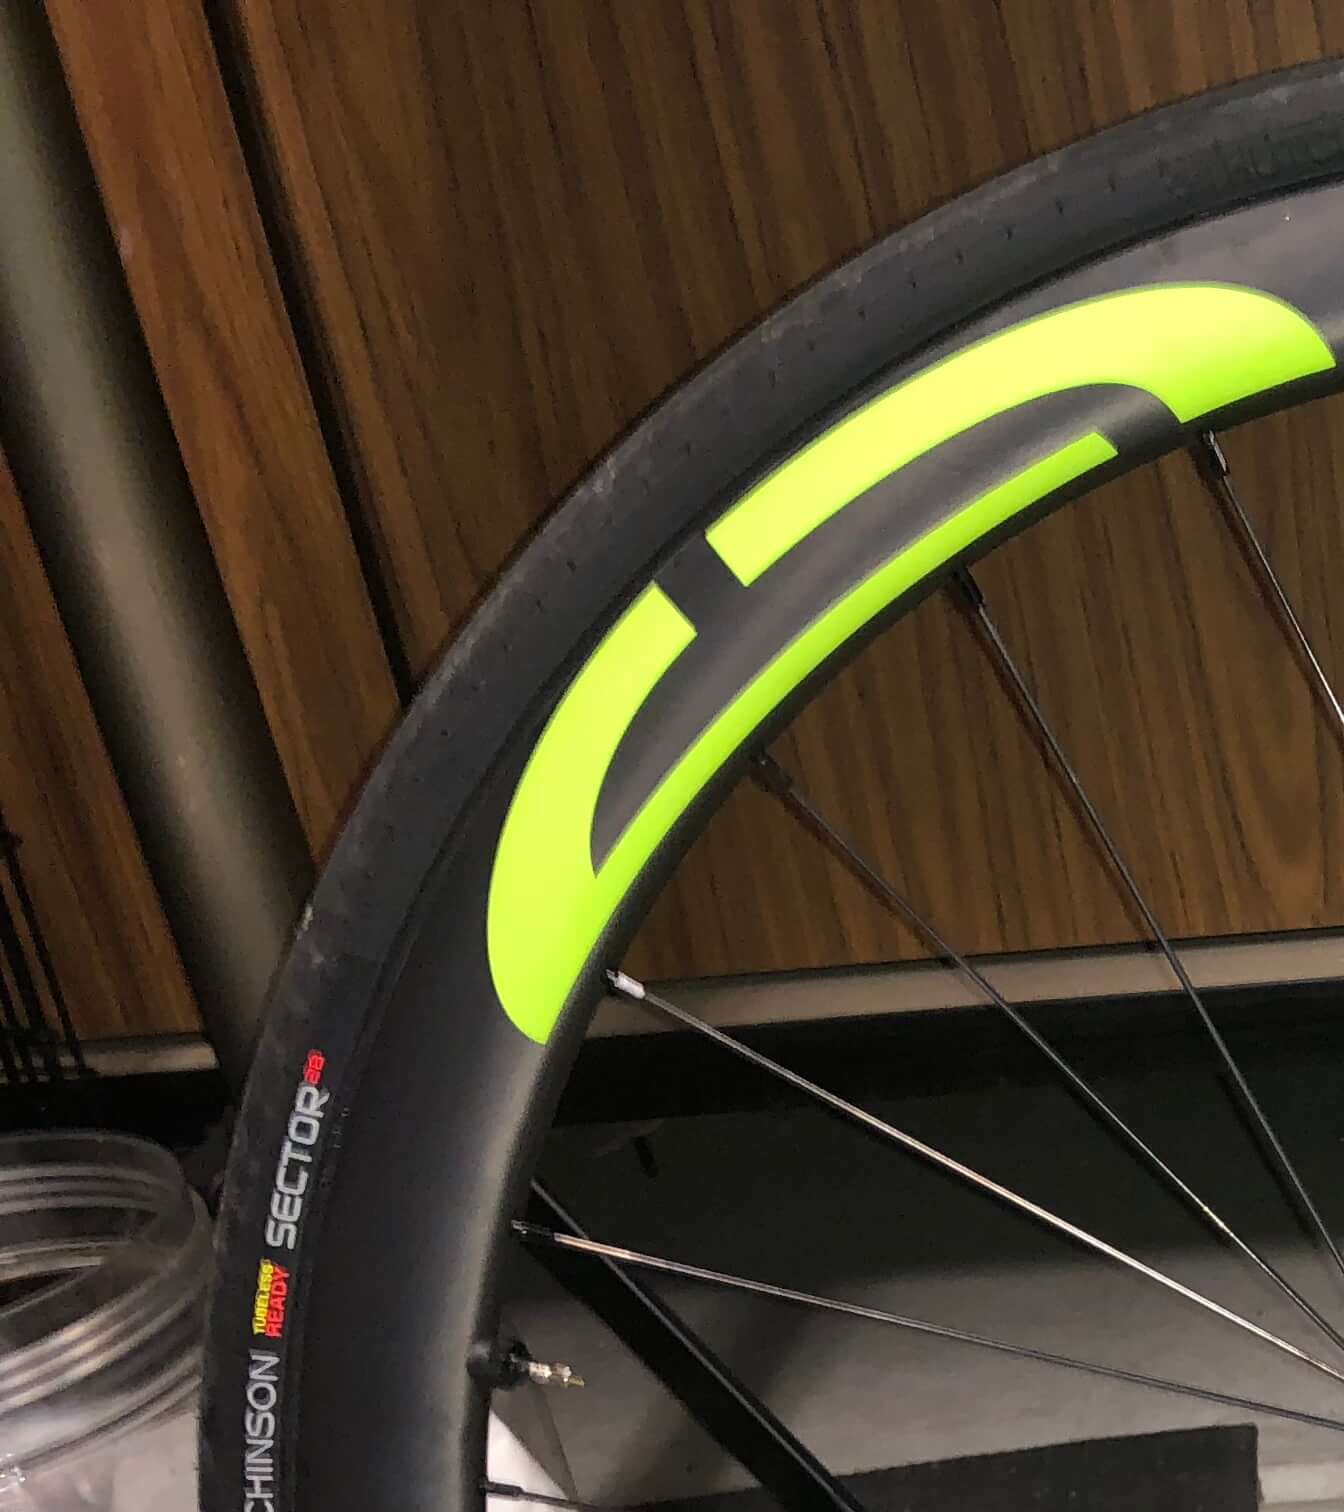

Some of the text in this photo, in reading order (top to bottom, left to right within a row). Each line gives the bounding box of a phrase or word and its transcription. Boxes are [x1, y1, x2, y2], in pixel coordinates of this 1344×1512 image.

[265, 1086, 331, 1250] SECTOR
[253, 1258, 274, 1336] TUBELESS
[264, 1263, 291, 1338] READY
